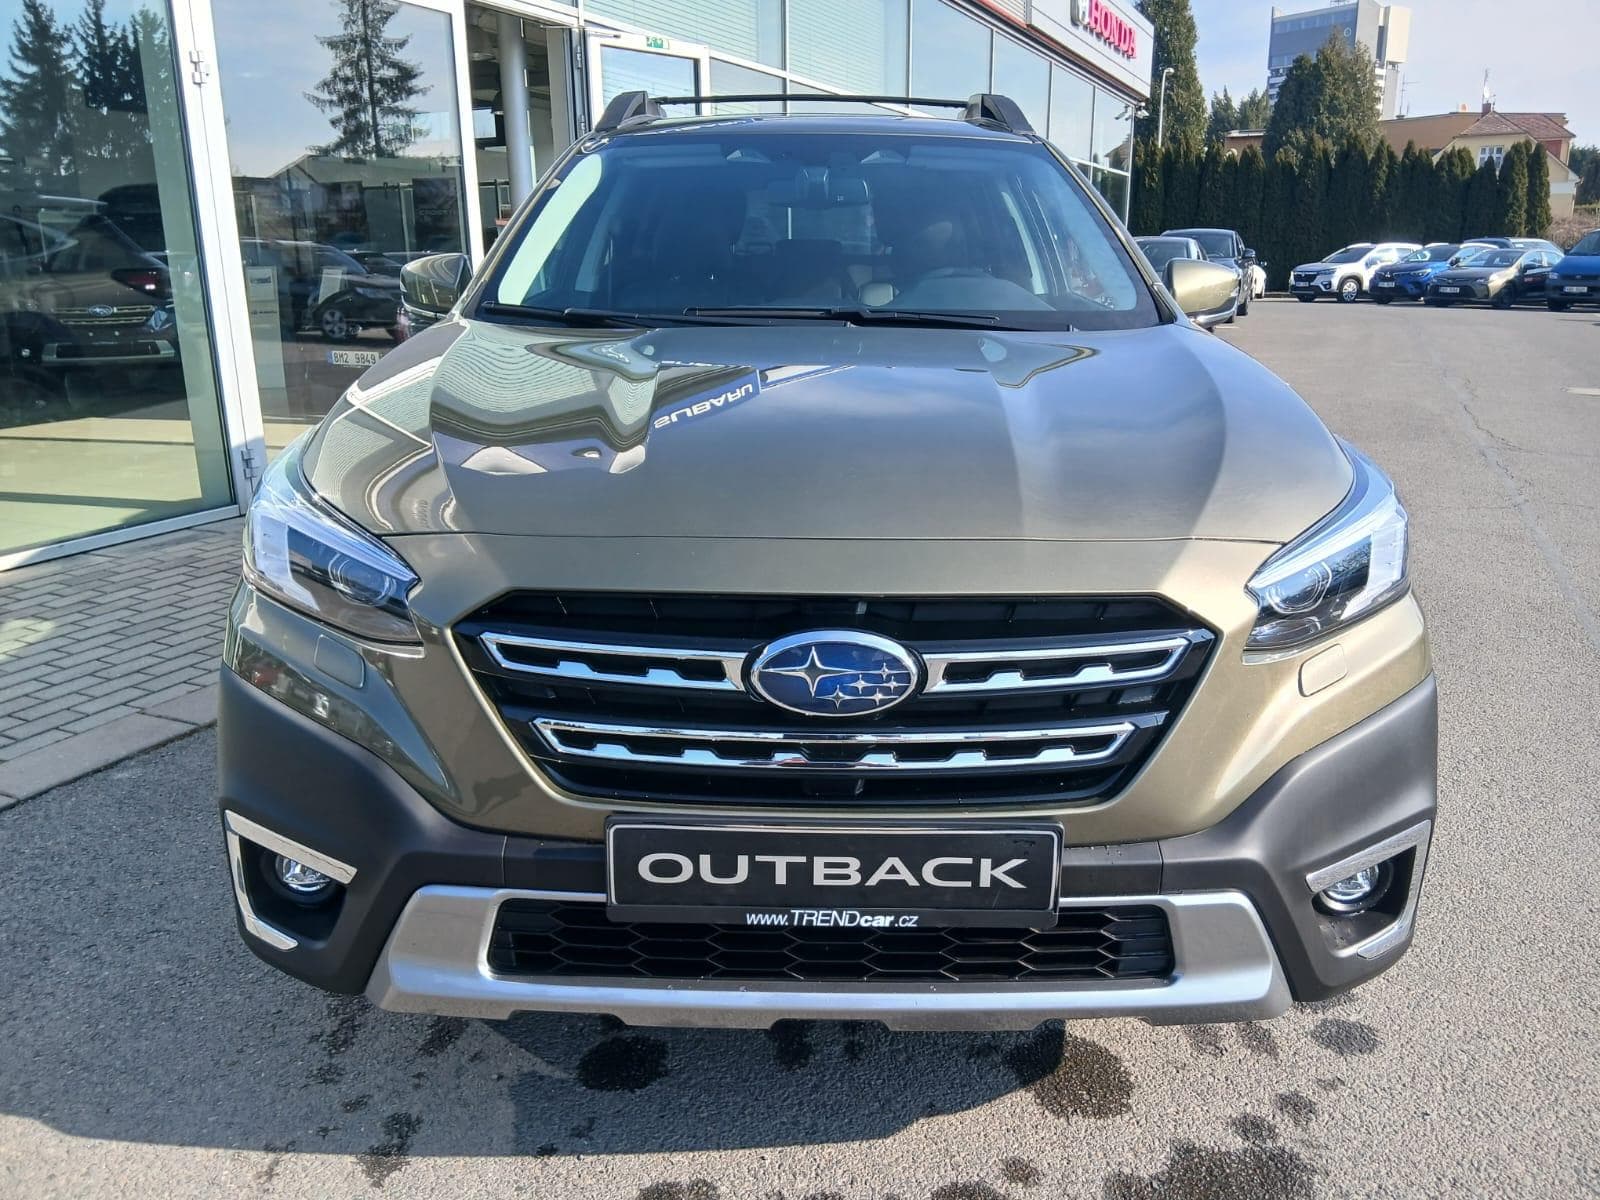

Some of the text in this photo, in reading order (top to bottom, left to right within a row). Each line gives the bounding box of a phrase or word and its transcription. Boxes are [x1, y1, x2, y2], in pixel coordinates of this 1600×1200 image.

[1089, 0, 1136, 58] HONDA
[637, 852, 1028, 889] OUTBACK
[746, 909, 919, 927] www.TRENDcar.cz
